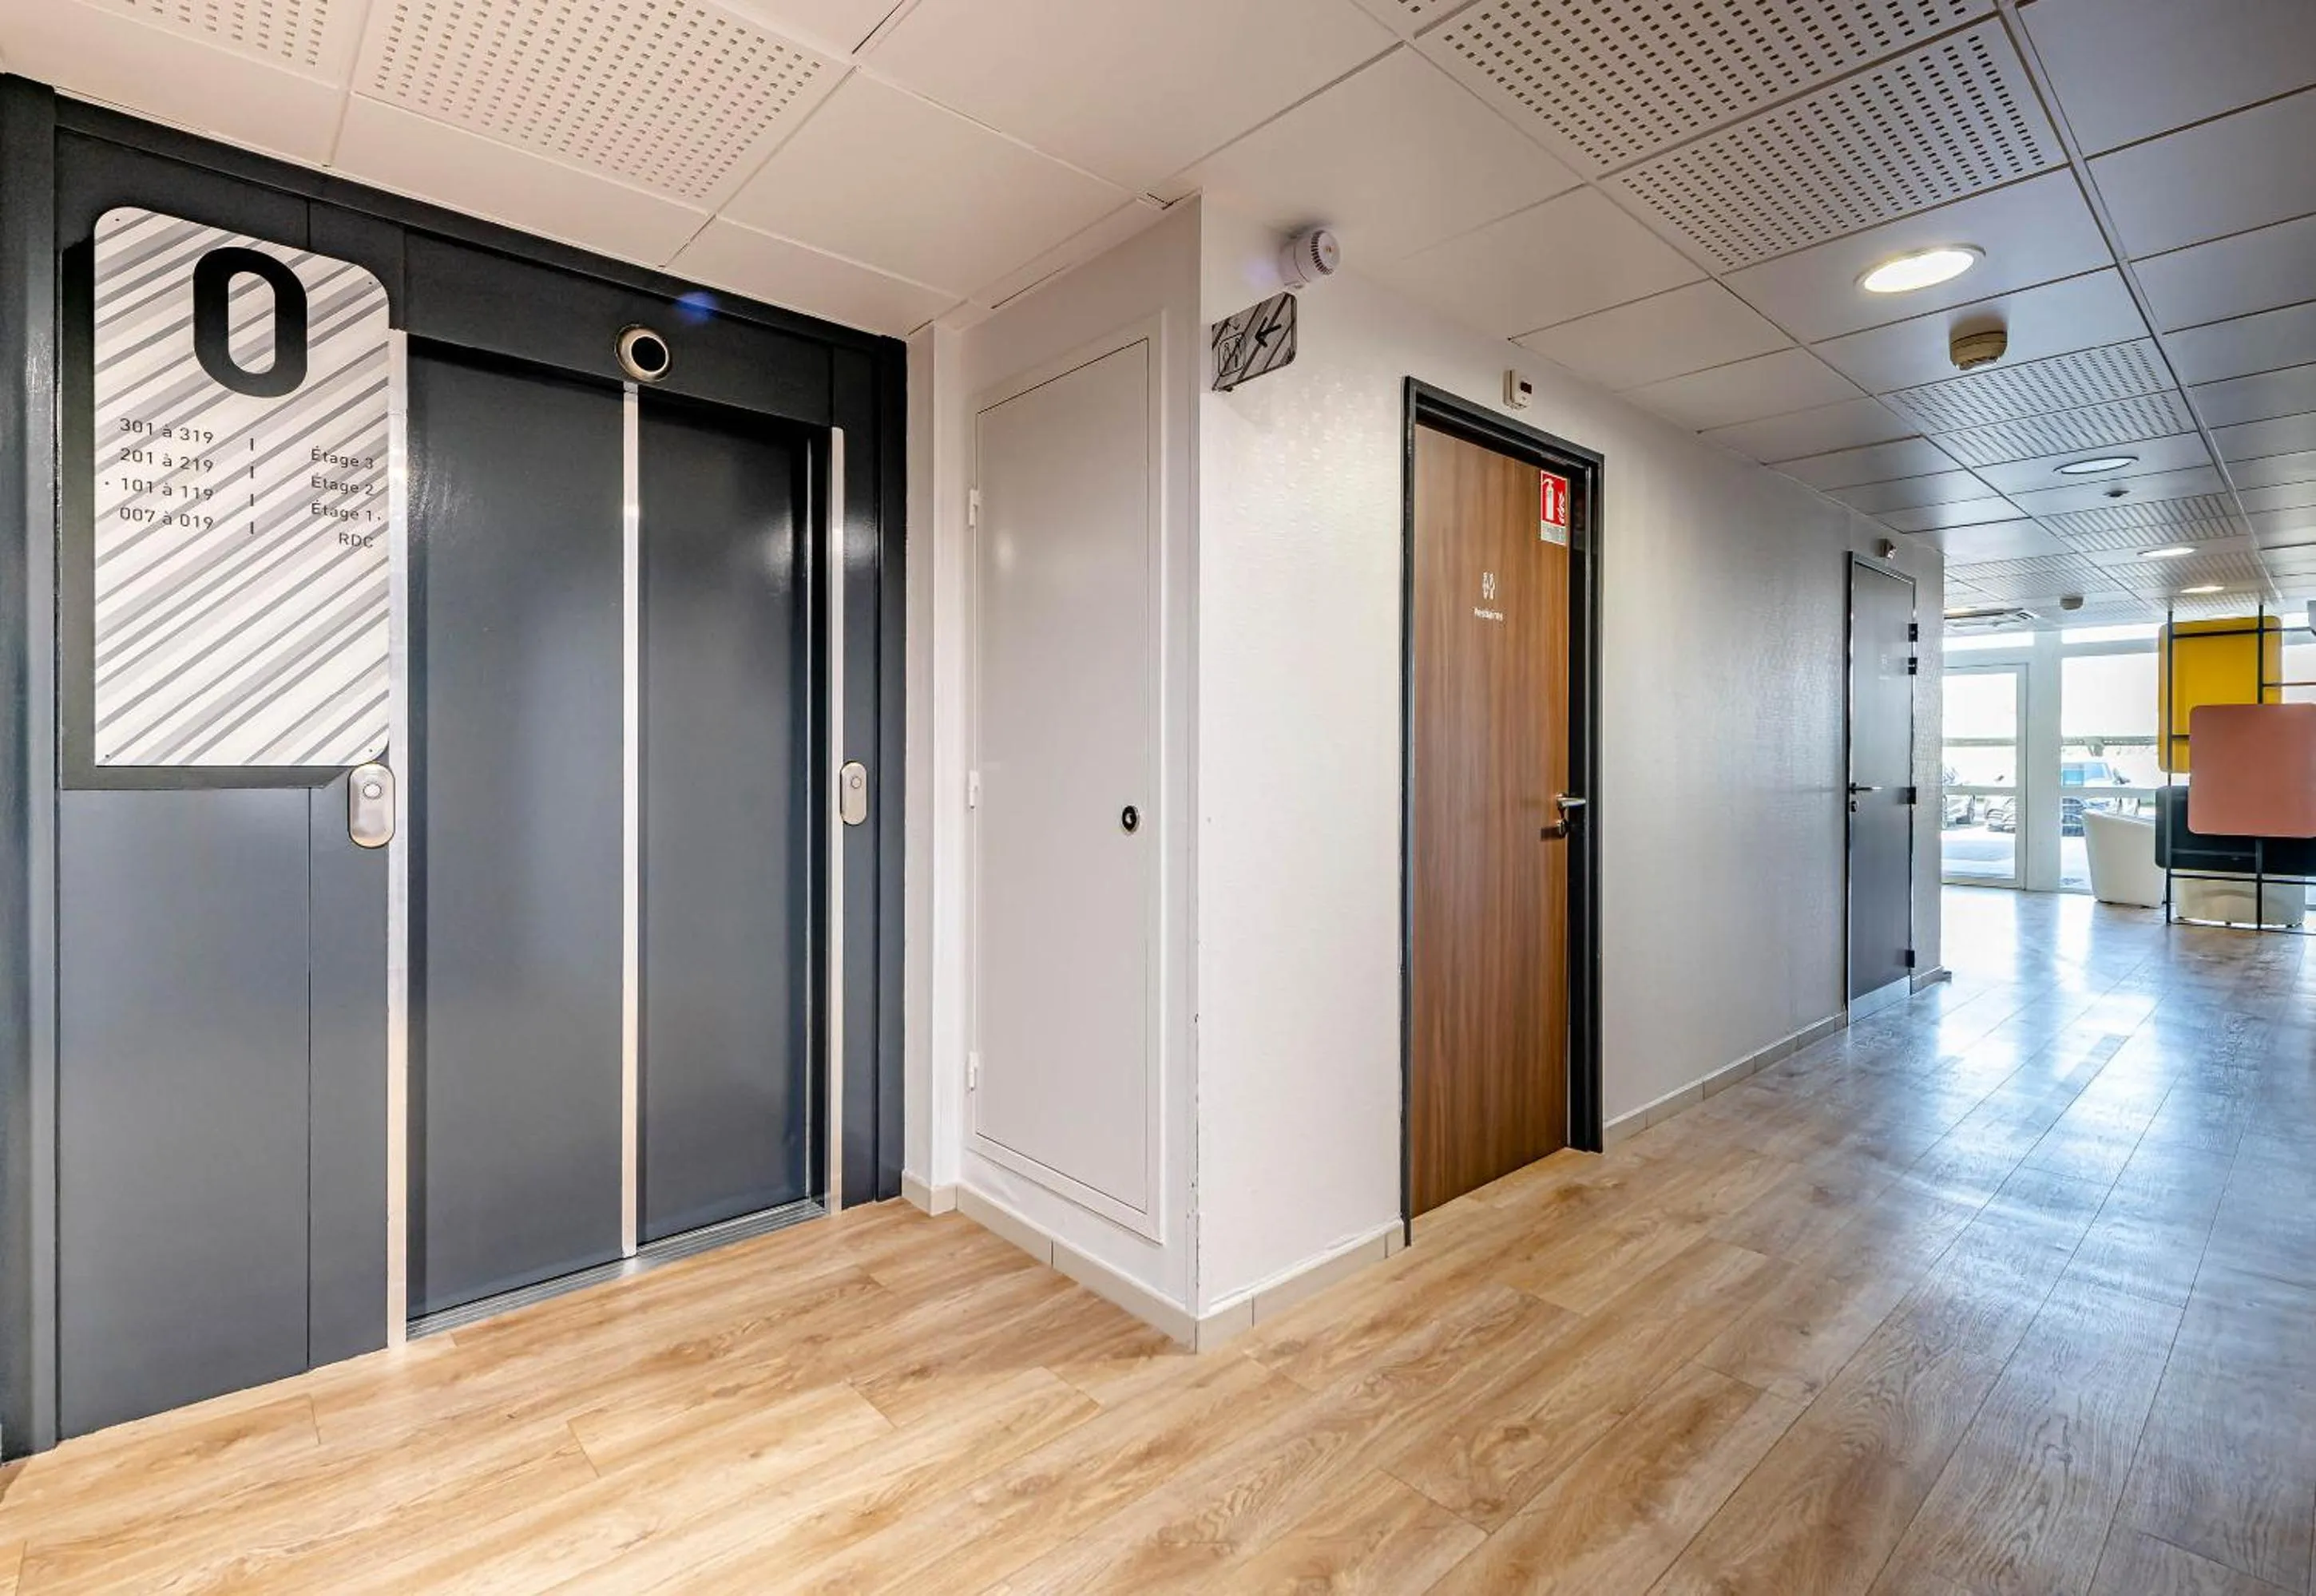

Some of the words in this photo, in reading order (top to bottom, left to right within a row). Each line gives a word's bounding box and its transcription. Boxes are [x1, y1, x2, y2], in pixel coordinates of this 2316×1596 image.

[193, 247, 308, 398] 0
[120, 418, 153, 436] 301
[162, 424, 173, 438] à
[180, 428, 214, 444] 319
[311, 446, 359, 469] Étage
[365, 457, 374, 469] 3
[120, 447, 153, 465] 201
[162, 453, 173, 467] à
[180, 456, 214, 473] 219
[311, 472, 359, 494] Étage
[365, 484, 374, 496] 2
[121, 477, 153, 494] 101
[162, 482, 173, 497] à
[180, 485, 214, 501] 119
[311, 499, 359, 522] Étage
[120, 506, 155, 523] 007
[162, 511, 173, 525] à
[180, 513, 214, 530] 019
[339, 532, 374, 549] RDC
